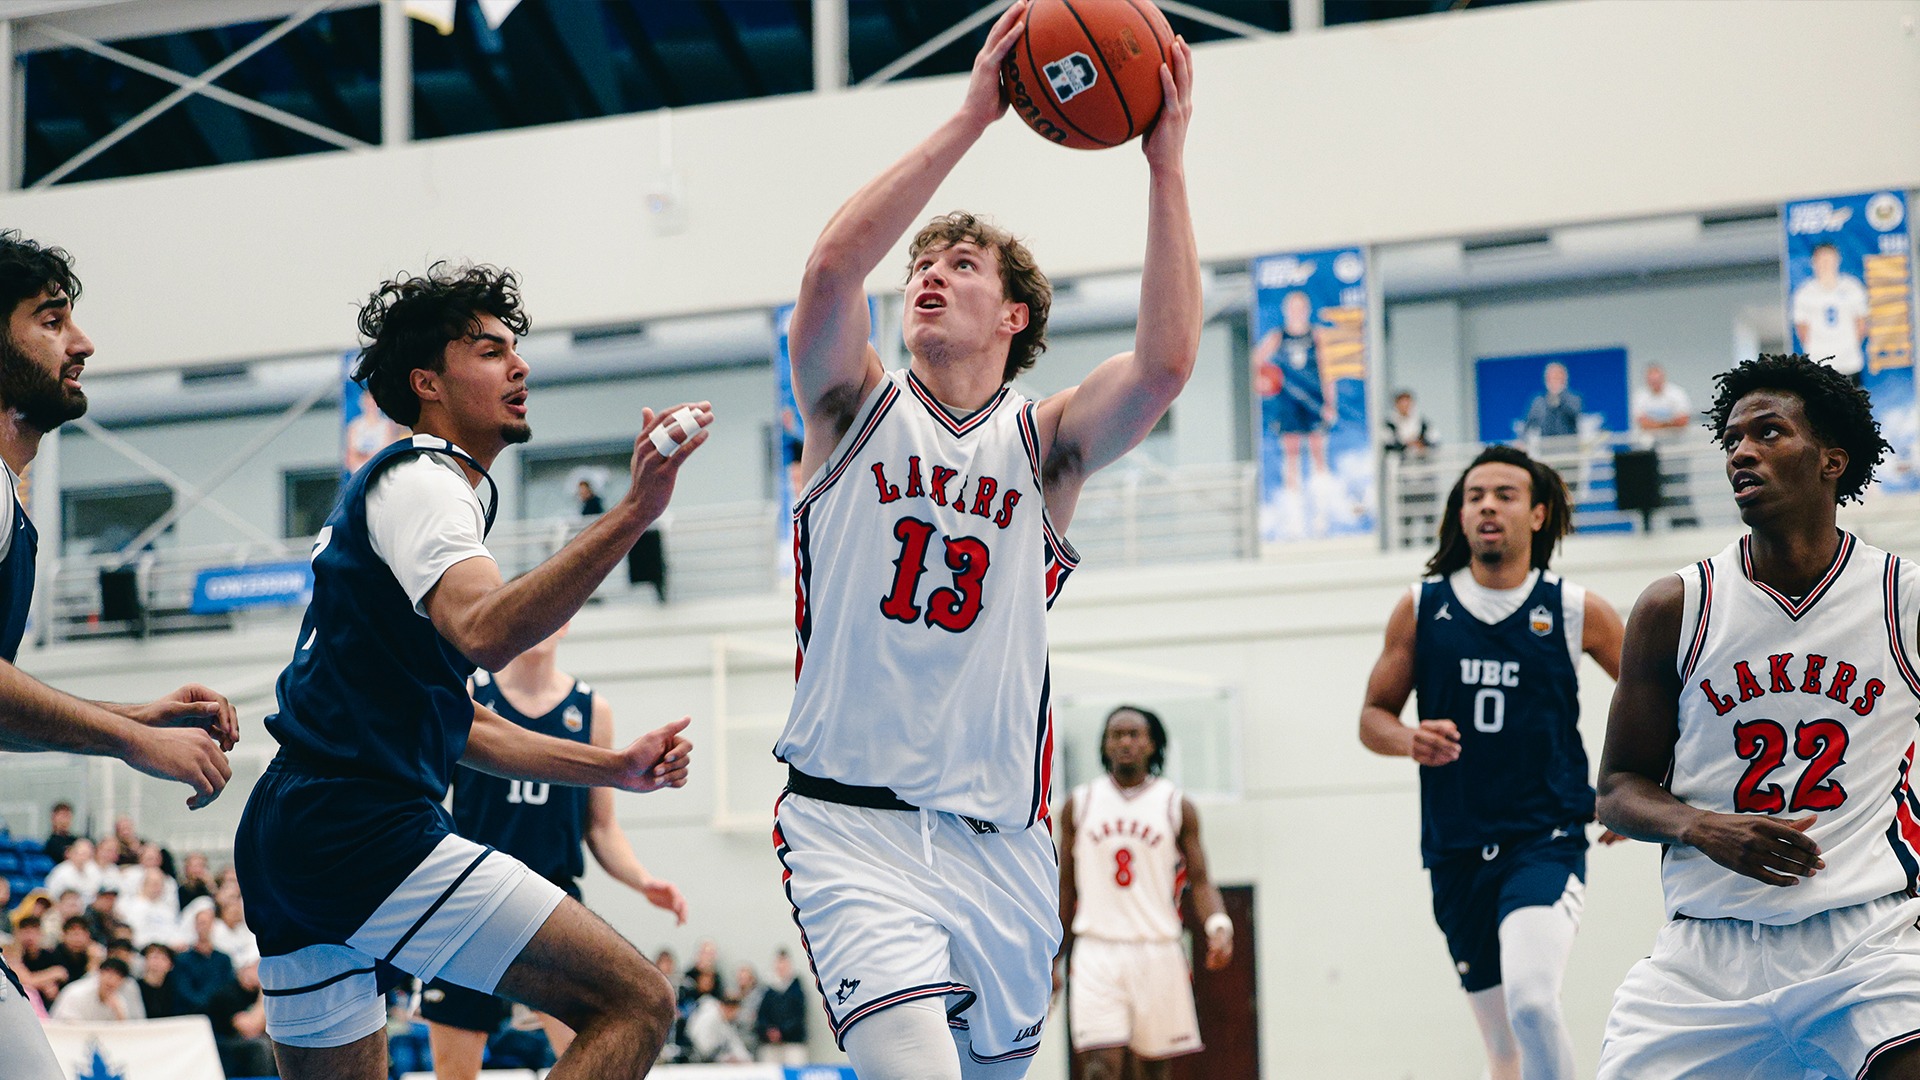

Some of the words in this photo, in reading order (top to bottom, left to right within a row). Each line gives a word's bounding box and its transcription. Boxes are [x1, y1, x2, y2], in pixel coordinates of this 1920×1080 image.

[1061, 59, 1084, 91] SPORTS
[879, 516, 990, 633] 13
[1460, 658, 1520, 687] UBC
[1700, 653, 1886, 716] LAKERS
[1473, 688, 1505, 733] 0
[1733, 718, 1850, 815] 22
[1115, 848, 1132, 888] 8
